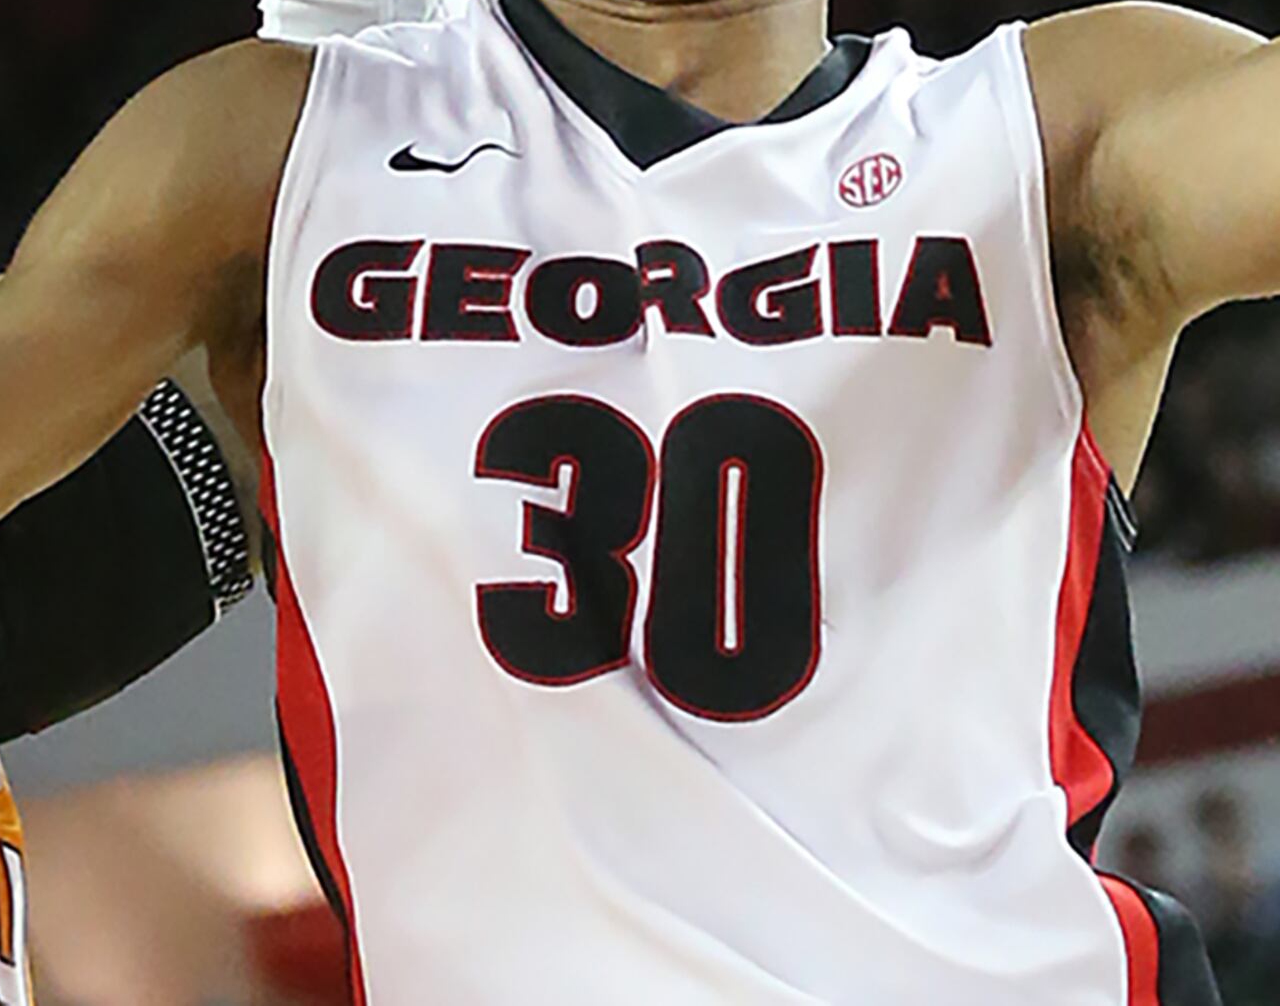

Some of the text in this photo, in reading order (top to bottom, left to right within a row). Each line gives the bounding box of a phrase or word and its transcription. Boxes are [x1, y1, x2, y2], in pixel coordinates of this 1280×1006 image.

[839, 154, 901, 207] SEC
[308, 236, 993, 348] GEORGIA
[474, 392, 825, 723] 30
